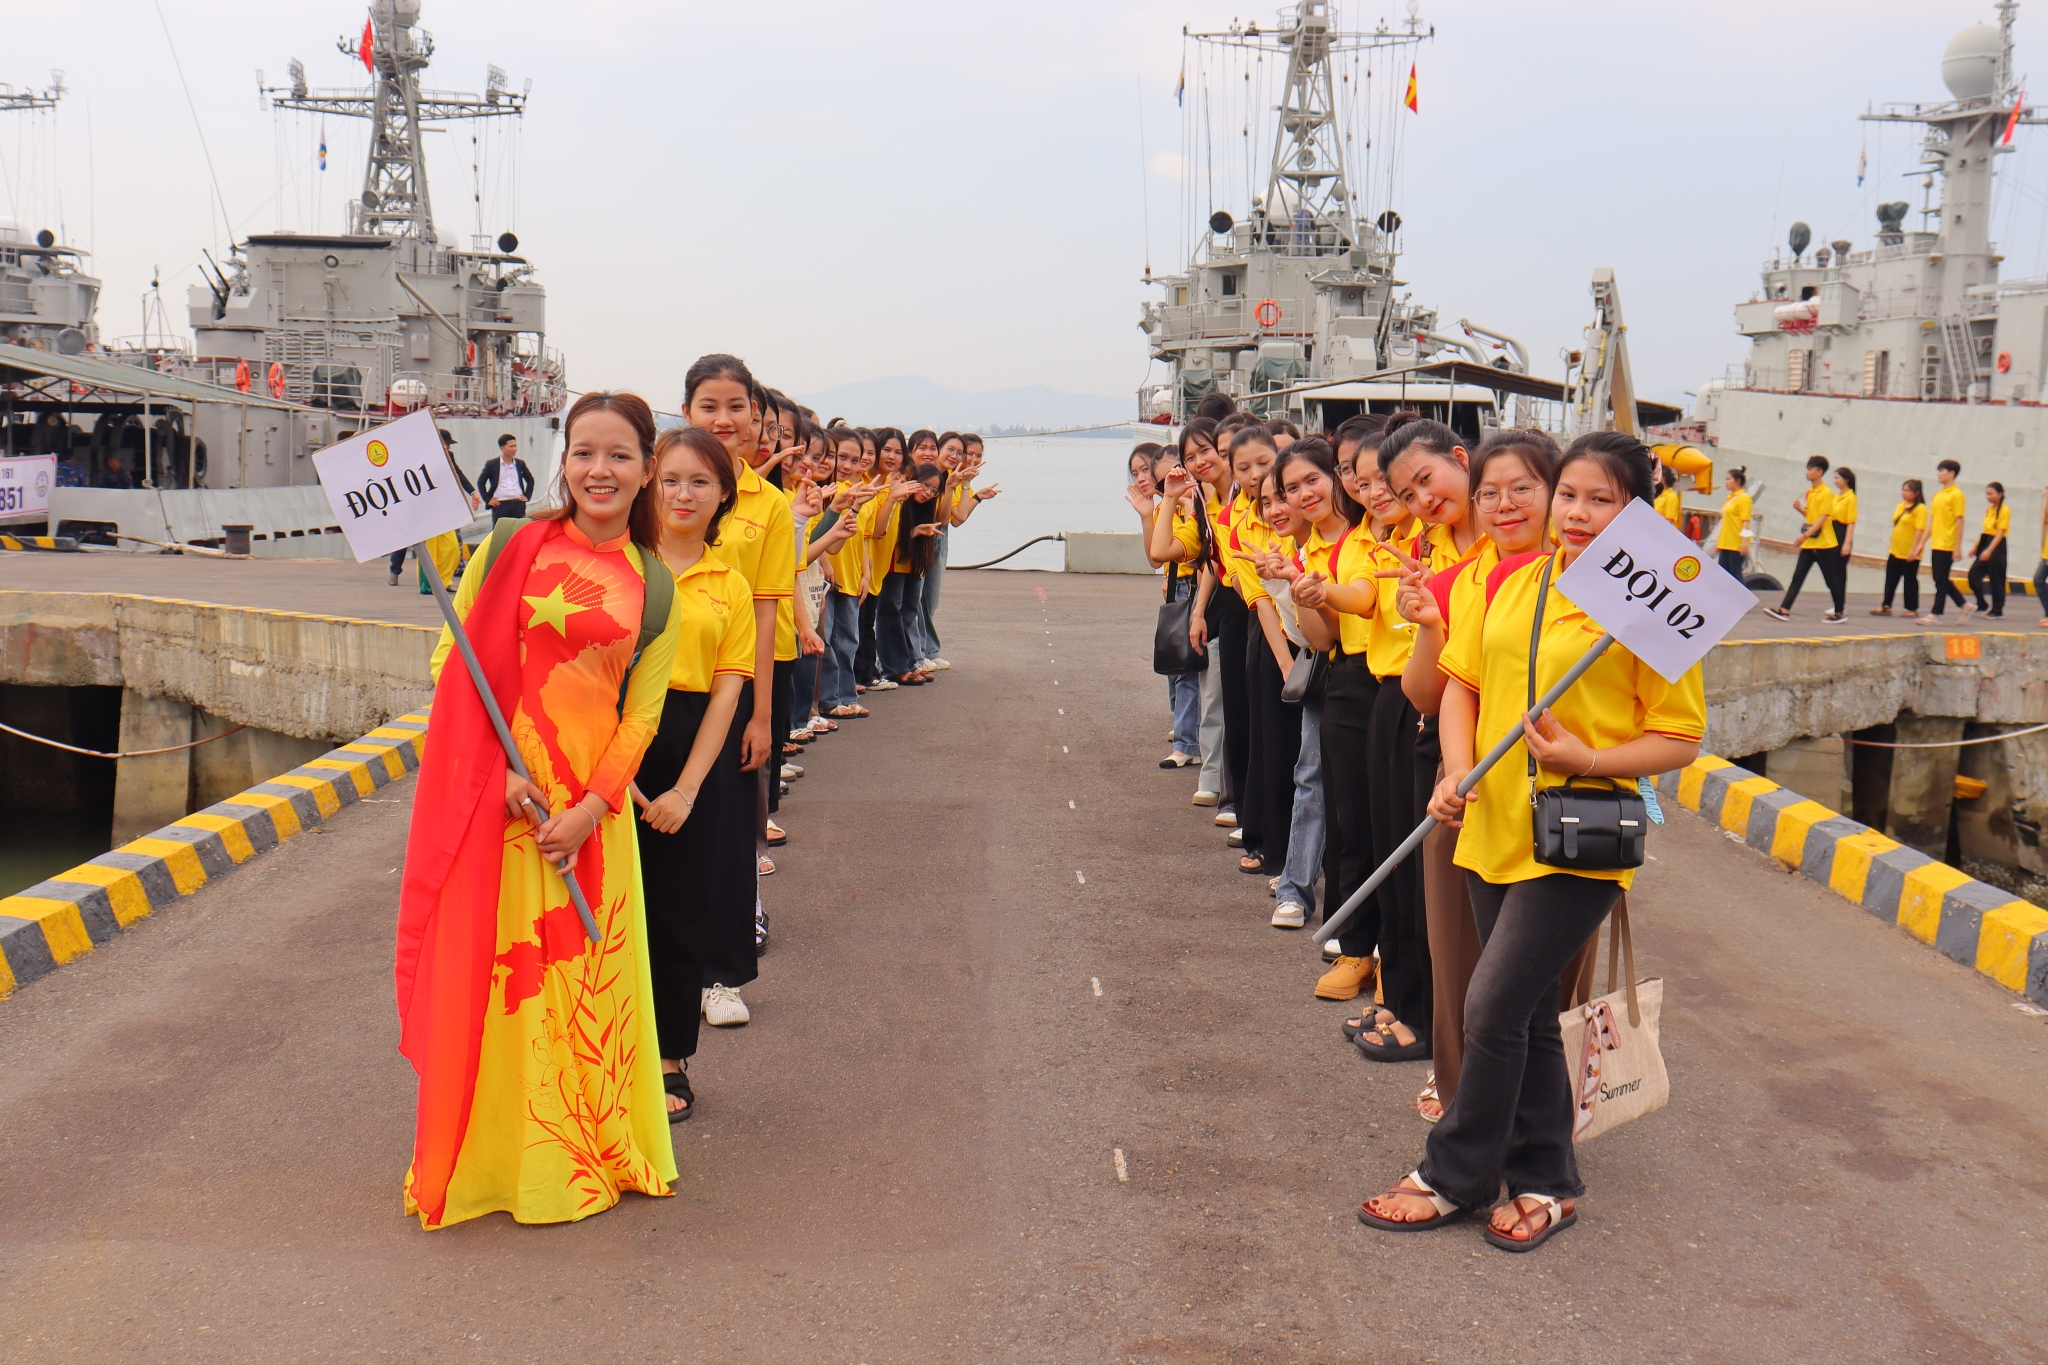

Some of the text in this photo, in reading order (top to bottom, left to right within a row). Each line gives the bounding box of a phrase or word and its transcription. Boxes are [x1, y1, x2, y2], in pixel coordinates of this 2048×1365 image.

[343, 463, 438, 519] ĐỘI 01
[1600, 547, 1674, 613] ĐỘI
[1666, 603, 1705, 640] 02
[1950, 638, 1977, 655] 18
[1600, 1078, 1642, 1103] Summer
